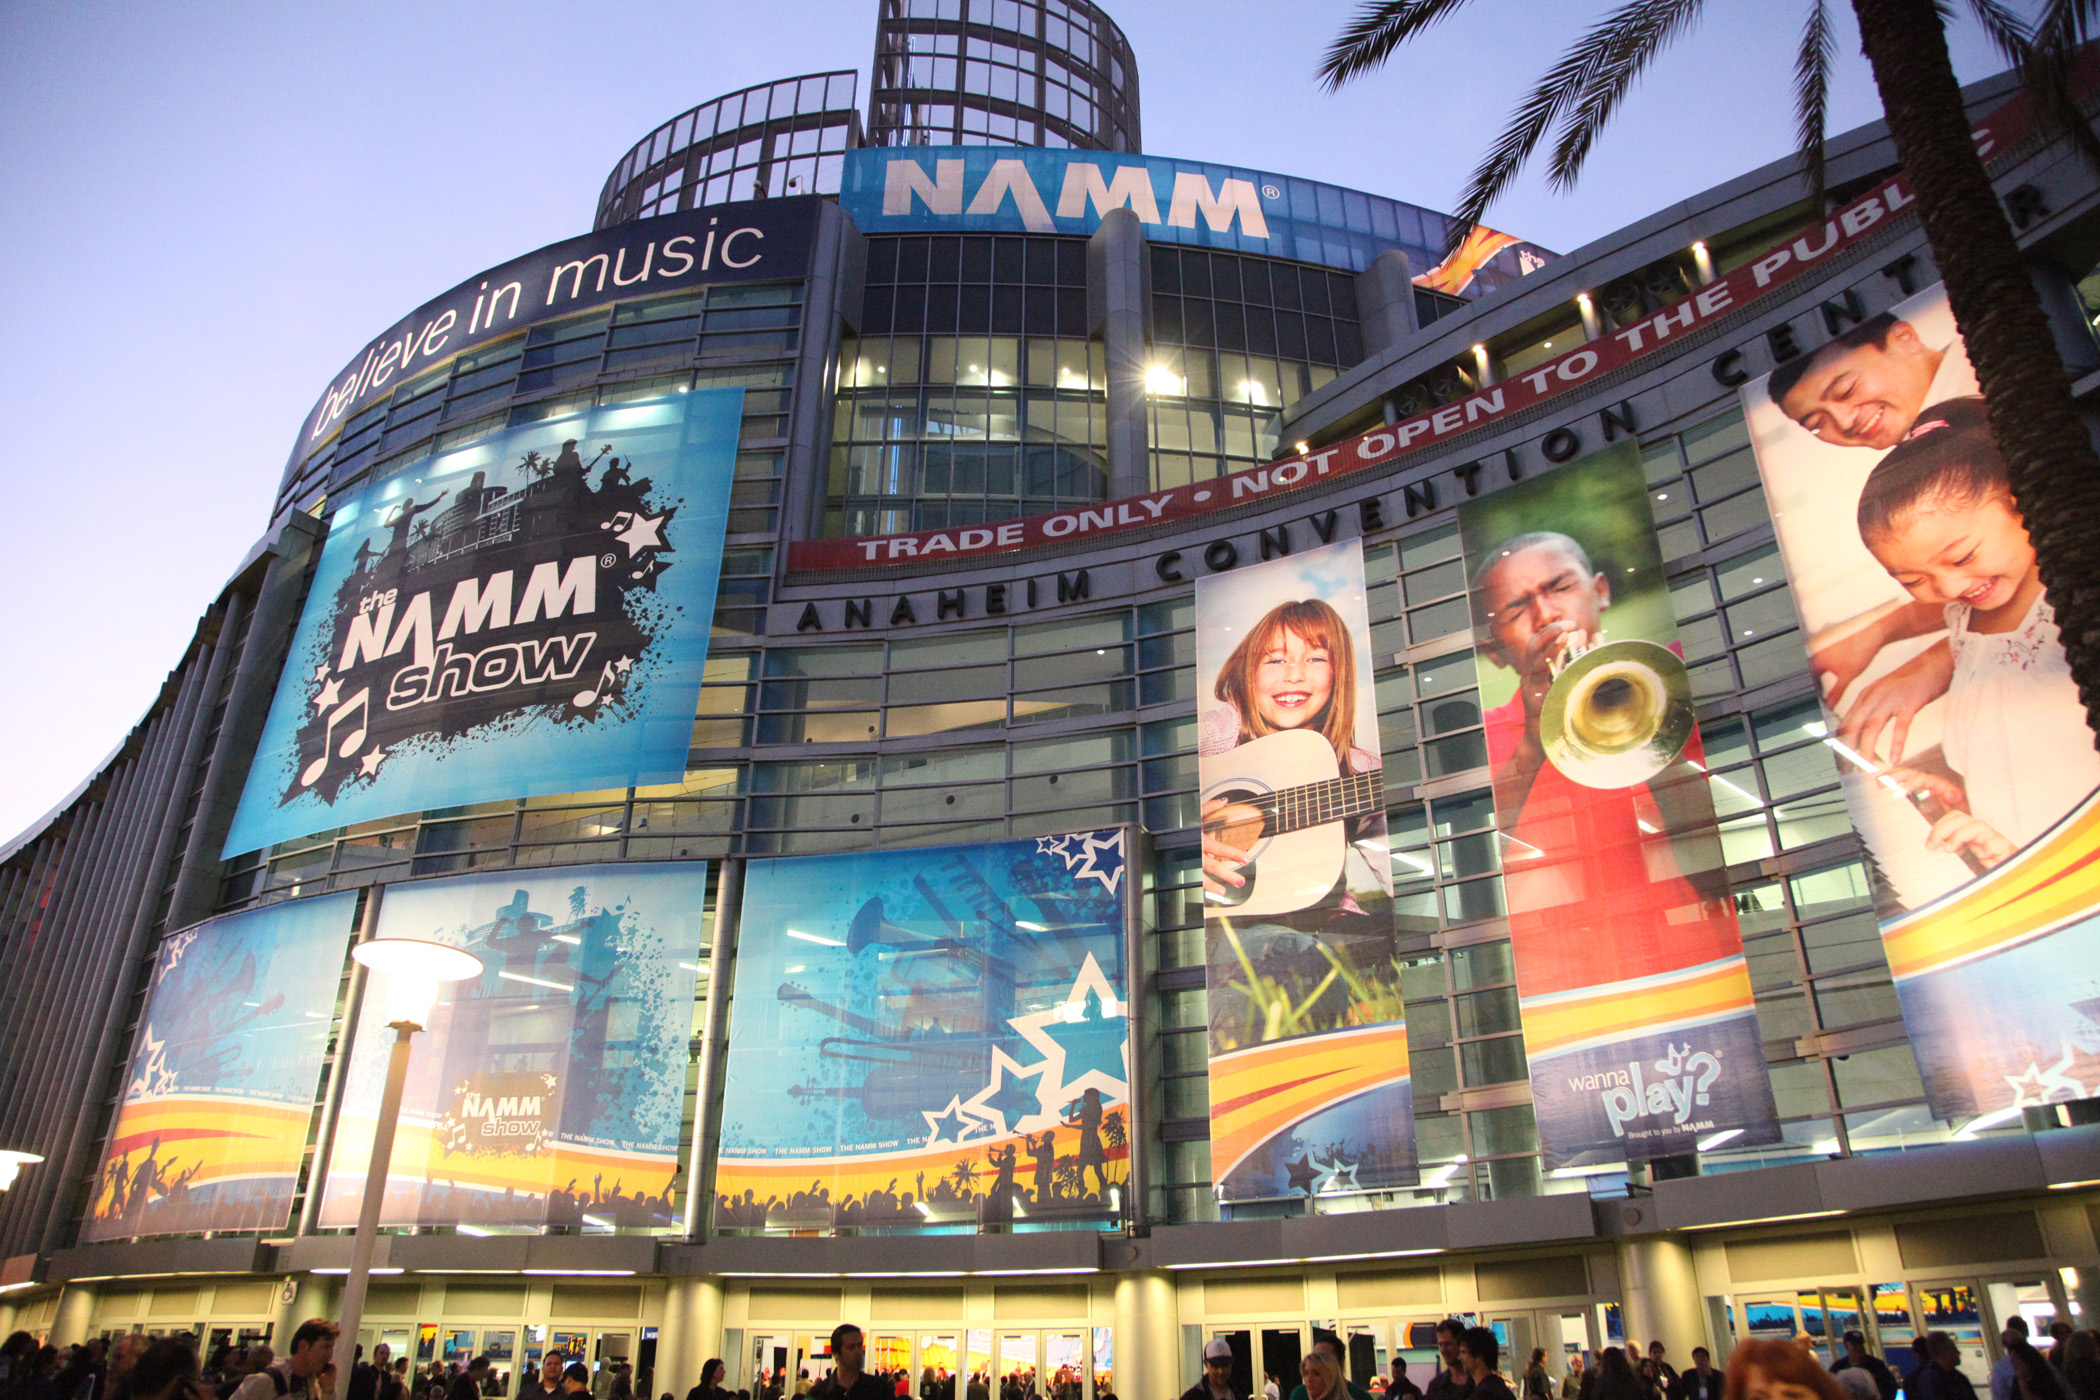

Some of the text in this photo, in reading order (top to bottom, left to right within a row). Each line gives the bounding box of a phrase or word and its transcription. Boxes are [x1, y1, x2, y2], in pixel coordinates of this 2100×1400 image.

[882, 158, 1270, 239] NAMM
[311, 217, 765, 441] believe in music
[796, 183, 2049, 632] ANAHEIM CONVENTION CENTR
[856, 522, 1025, 561] TRADE
[1041, 494, 1175, 537] ONLY
[1231, 448, 1340, 499] NOT
[1356, 389, 1506, 460] OPEN
[1521, 352, 1599, 394] TO
[1614, 280, 1734, 352] THE
[359, 587, 398, 616] the
[336, 555, 598, 674] NAMM
[386, 631, 598, 711] show
[1568, 1069, 1631, 1093] wanna
[466, 1091, 481, 1099] the
[1601, 1050, 1722, 1138] play?
[461, 1096, 541, 1123] NAMM
[481, 1118, 541, 1136] show
[1681, 1120, 1715, 1133] NAMM
[561, 1132, 573, 1141] THE
[574, 1135, 594, 1144] NAMM
[595, 1138, 615, 1146] SHOW
[622, 1140, 678, 1152] THE NAMM SHOW
[747, 1147, 768, 1155] SHOW
[775, 1145, 833, 1155] THE NAMM SHOW
[840, 1139, 899, 1152] THE NAMM SHOW
[906, 1137, 920, 1145] THE
